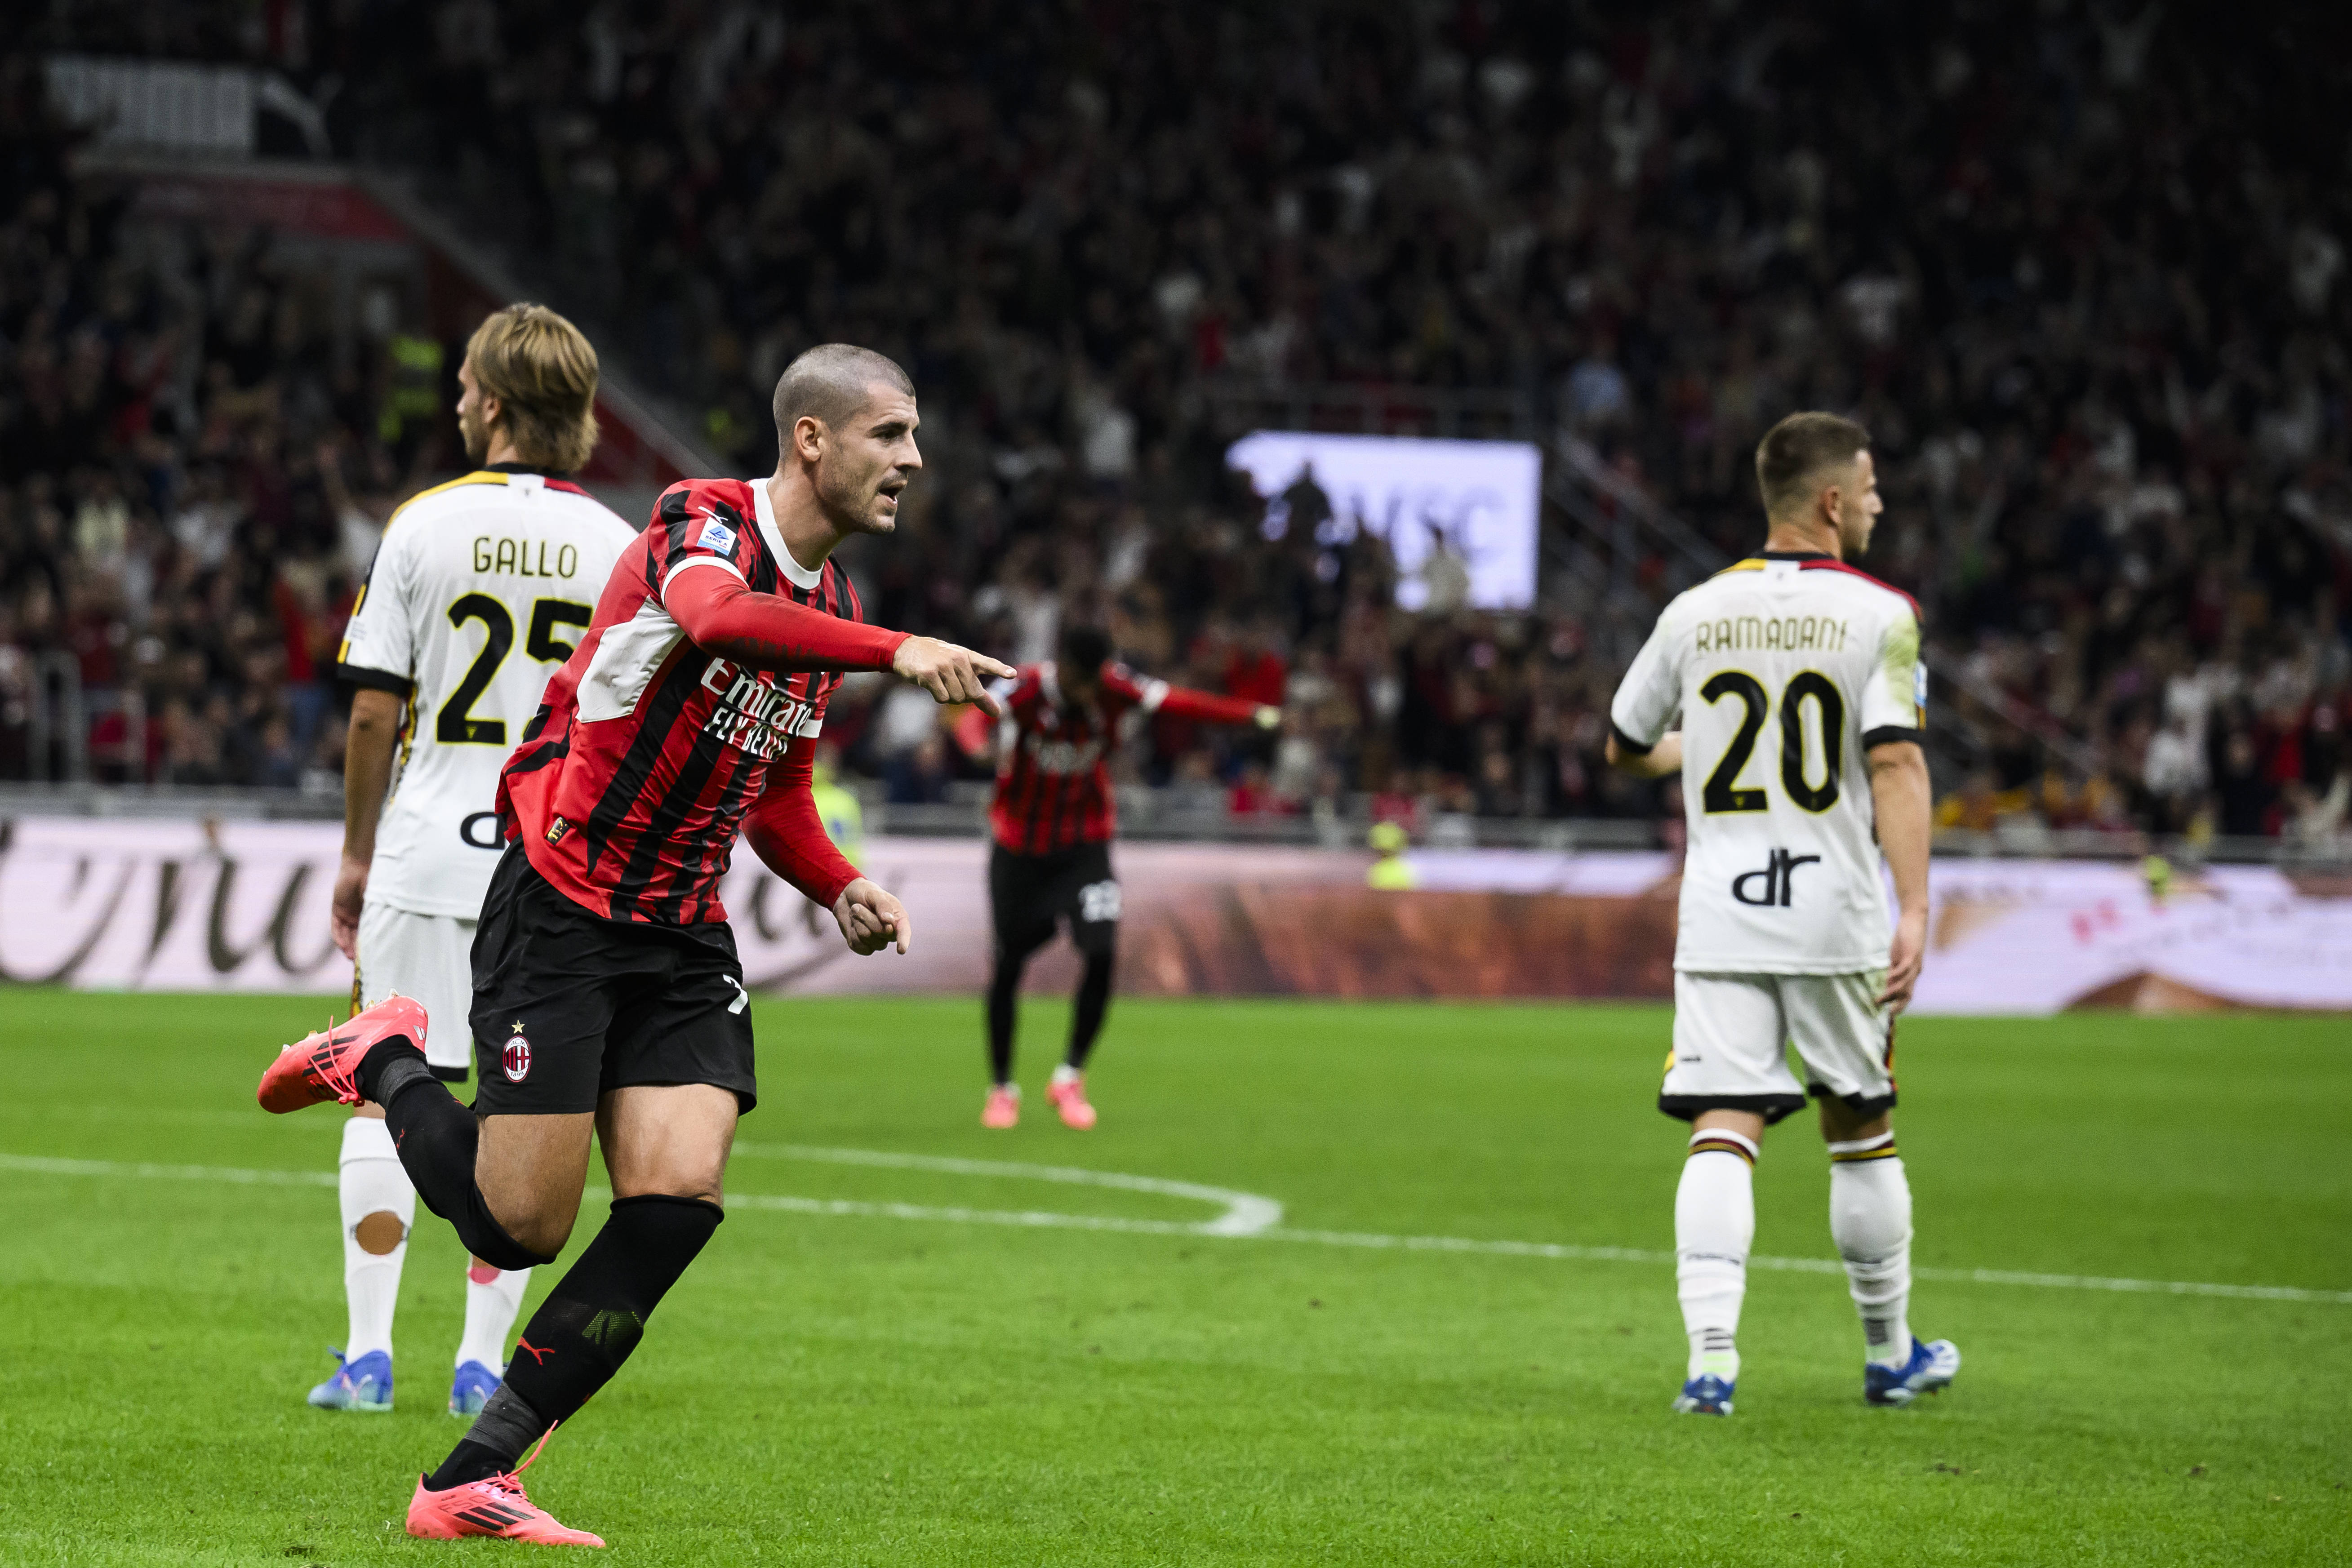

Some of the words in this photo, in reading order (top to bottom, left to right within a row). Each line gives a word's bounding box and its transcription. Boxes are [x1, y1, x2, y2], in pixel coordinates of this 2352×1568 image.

[473, 537, 578, 579] GALLO
[1696, 615, 1848, 653] RAMADANI
[435, 591, 594, 746] 25
[703, 706, 749, 744] FLY
[1699, 669, 1844, 814] 20
[1732, 848, 1821, 907] dr
[723, 974, 748, 1015] 7
